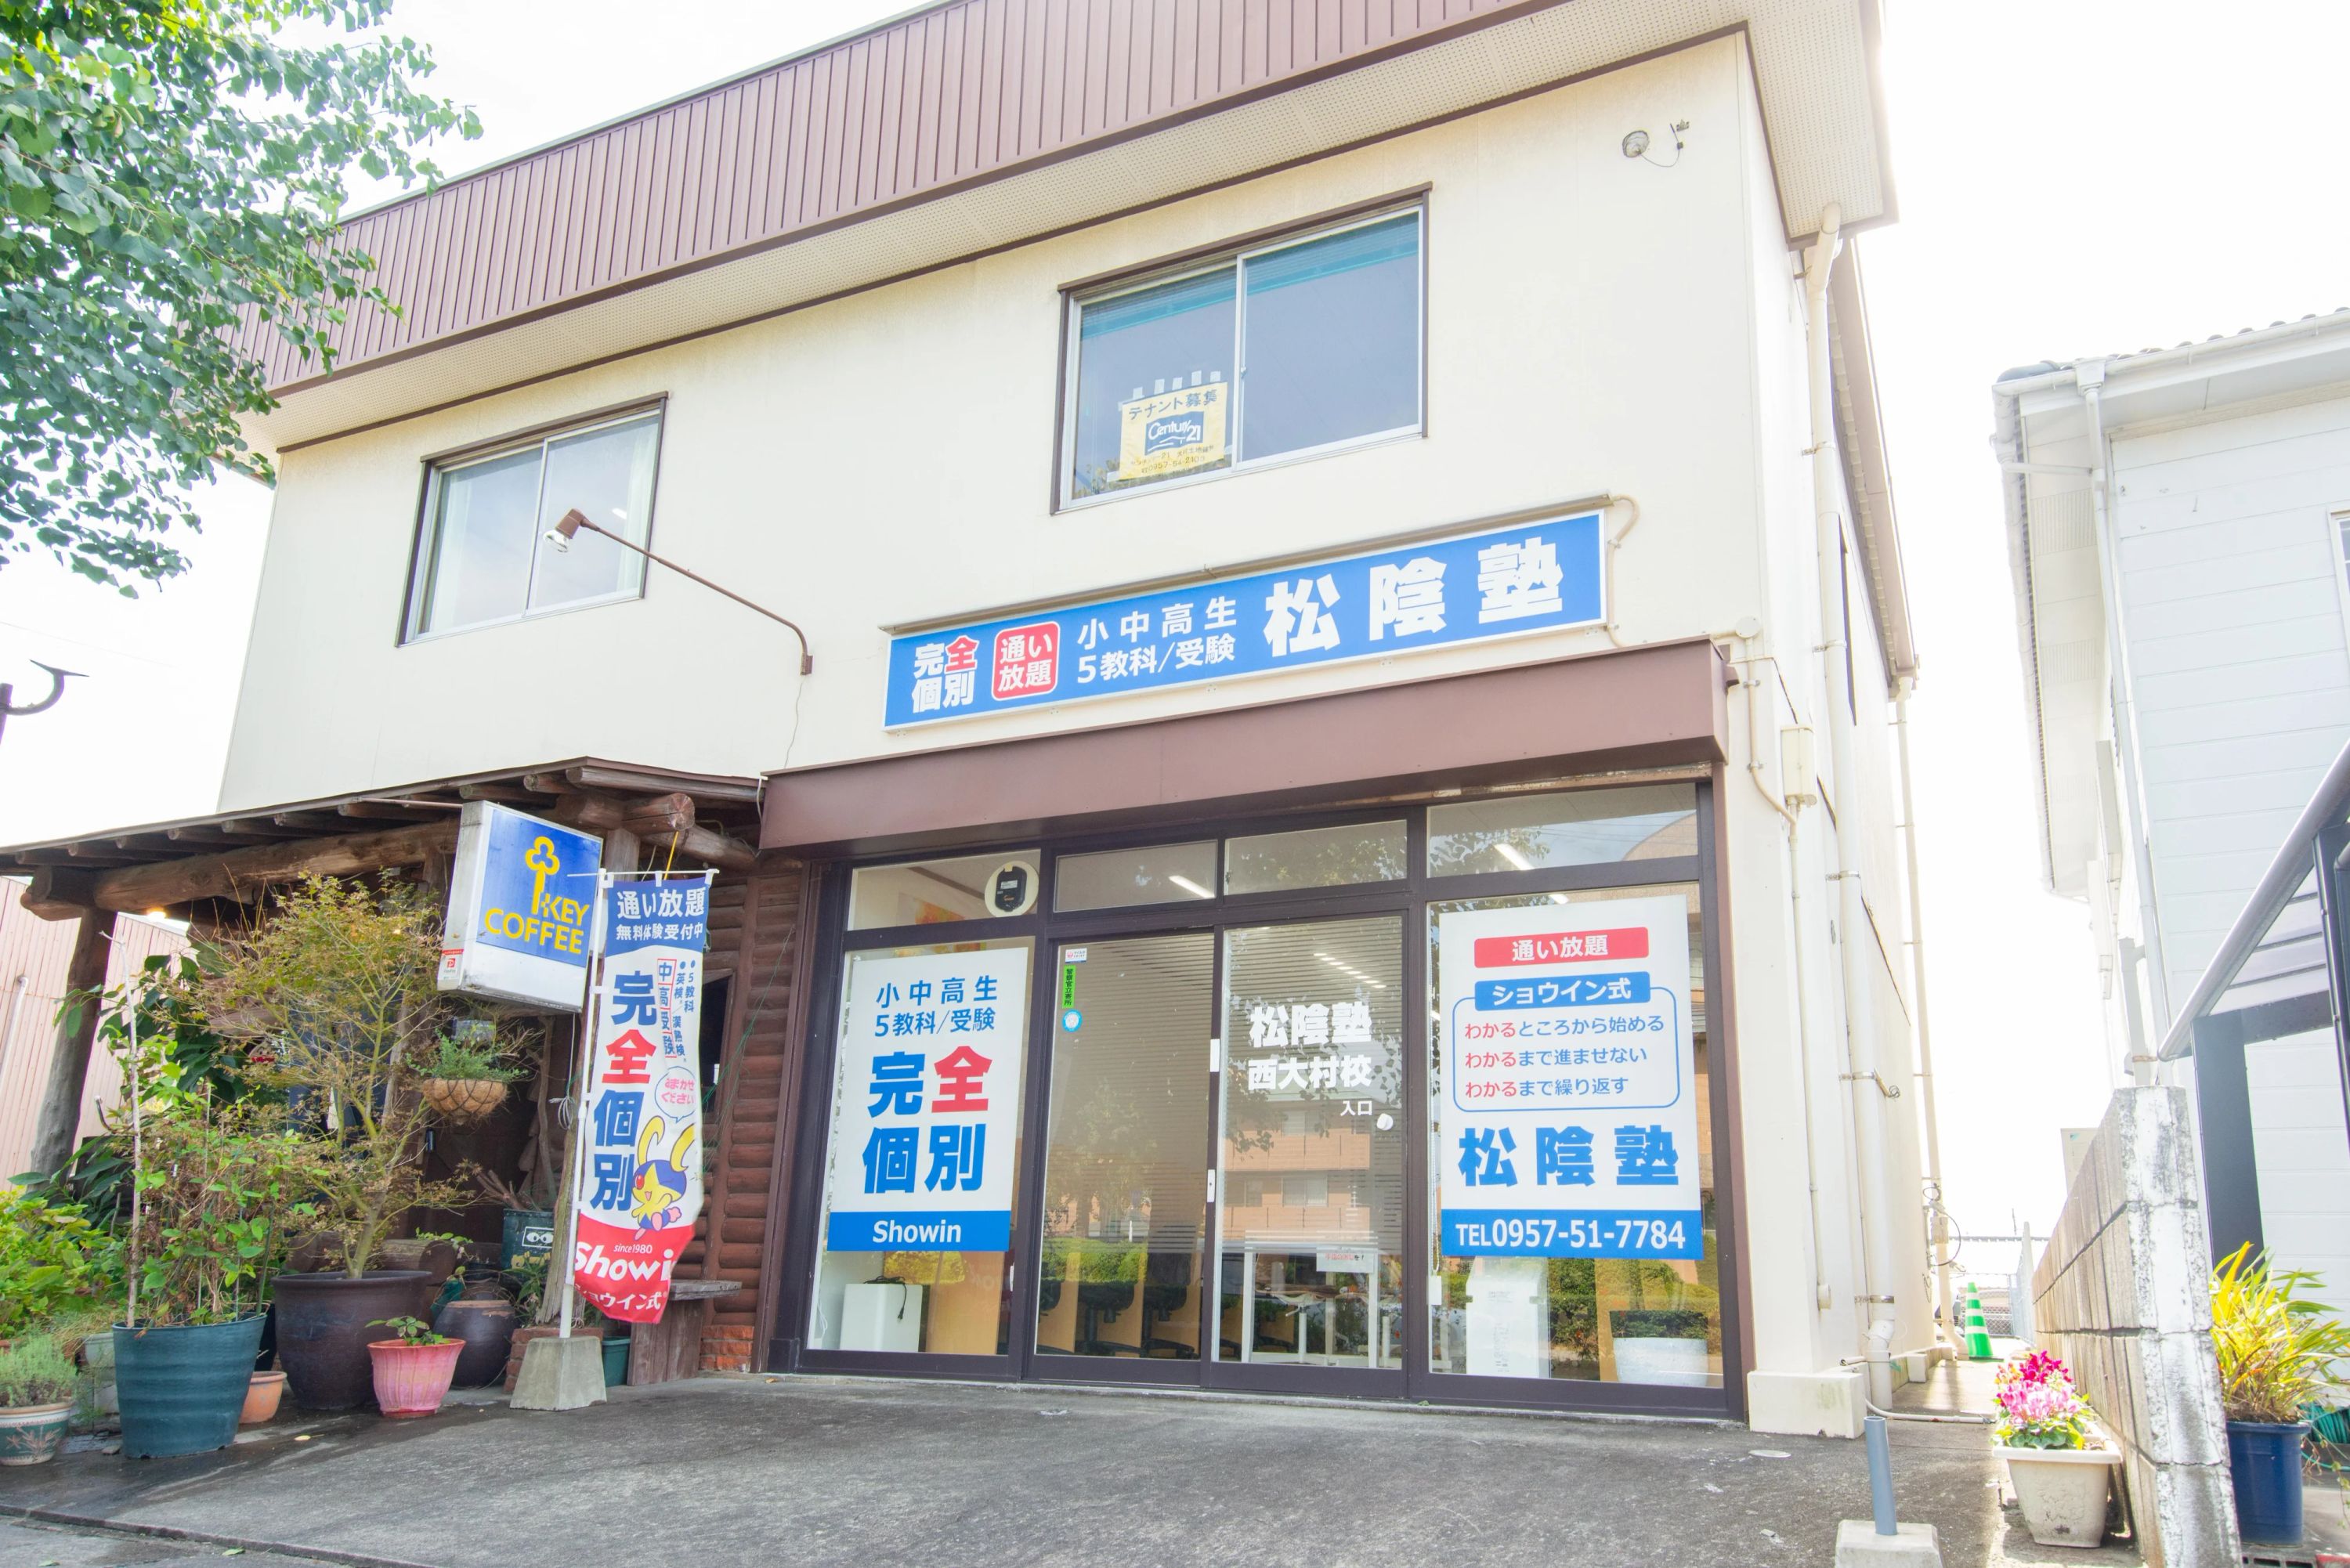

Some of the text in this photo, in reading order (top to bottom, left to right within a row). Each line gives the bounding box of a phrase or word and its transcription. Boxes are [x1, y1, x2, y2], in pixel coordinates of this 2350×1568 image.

[1128, 388, 1217, 420] テナント募集
[1263, 537, 1563, 656] 松陰塾
[1078, 596, 1237, 649] 小中高生
[913, 635, 979, 679] 完全
[1000, 634, 1053, 663] 通い
[912, 671, 975, 714] 個別
[997, 659, 1053, 692] 放題
[542, 893, 589, 927] KEY
[617, 887, 706, 919] 通い放題
[484, 908, 584, 954] COFFEE
[616, 922, 703, 941] 無料体験受付中
[1512, 934, 1609, 962] 通い放題
[876, 974, 998, 1009] 小中高生
[1492, 977, 1632, 1006] ショウイン式
[1249, 1001, 1372, 1048] 松陰塾
[1465, 1015, 1665, 1040] わかるところから始める
[1248, 1054, 1372, 1090] 西大村校
[1465, 1048, 1647, 1068] わかるまで進ませない
[590, 970, 657, 1212] 完全個別
[867, 1045, 992, 1118] 完全
[1465, 1077, 1629, 1098] わかるまで繰り返す
[1340, 1100, 1372, 1116] 入口
[862, 1122, 987, 1195] 個別
[1457, 1124, 1679, 1187] 松陰塾
[873, 1219, 962, 1244] Showin
[575, 1241, 677, 1281] Showi
